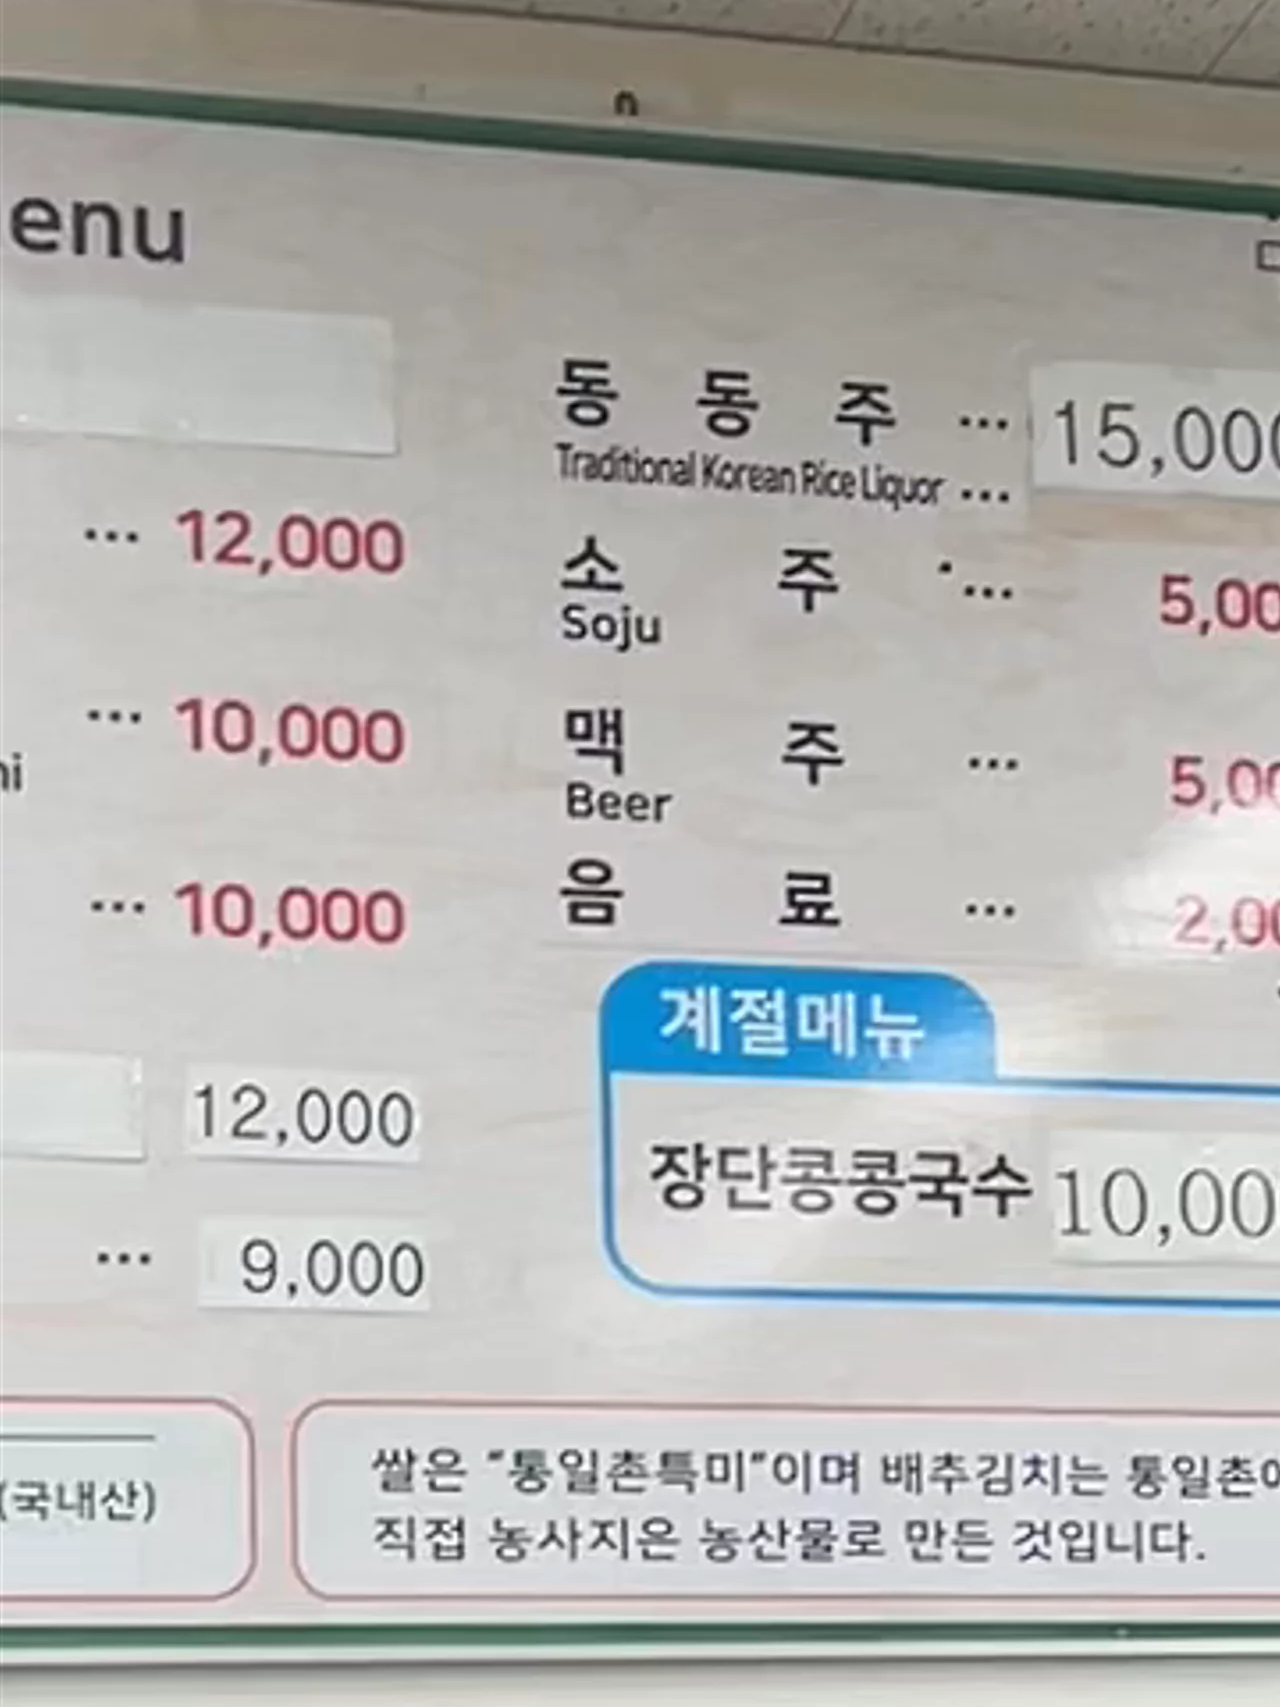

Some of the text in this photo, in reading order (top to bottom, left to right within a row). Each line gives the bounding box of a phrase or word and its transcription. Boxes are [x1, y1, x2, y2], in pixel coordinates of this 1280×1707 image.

[556, 442, 945, 511] Traditional Korean Rice Liquor
[177, 509, 405, 575] 12,000
[562, 603, 662, 653] Soju
[176, 698, 405, 766] 10,000
[566, 782, 673, 822] Beer
[176, 883, 405, 948] 10,000
[660, 985, 926, 1061] 계절메뉴
[195, 1083, 415, 1148] 12,000
[650, 1141, 1034, 1219] 장단콩콩국수
[242, 1238, 425, 1298] 9,000
[371, 1447, 468, 1494] 쌀은
[881, 1451, 1109, 1498] 배추김치는
[374, 1516, 1207, 1563] 직접 농사지은 농산물로 만든 것입니다.
